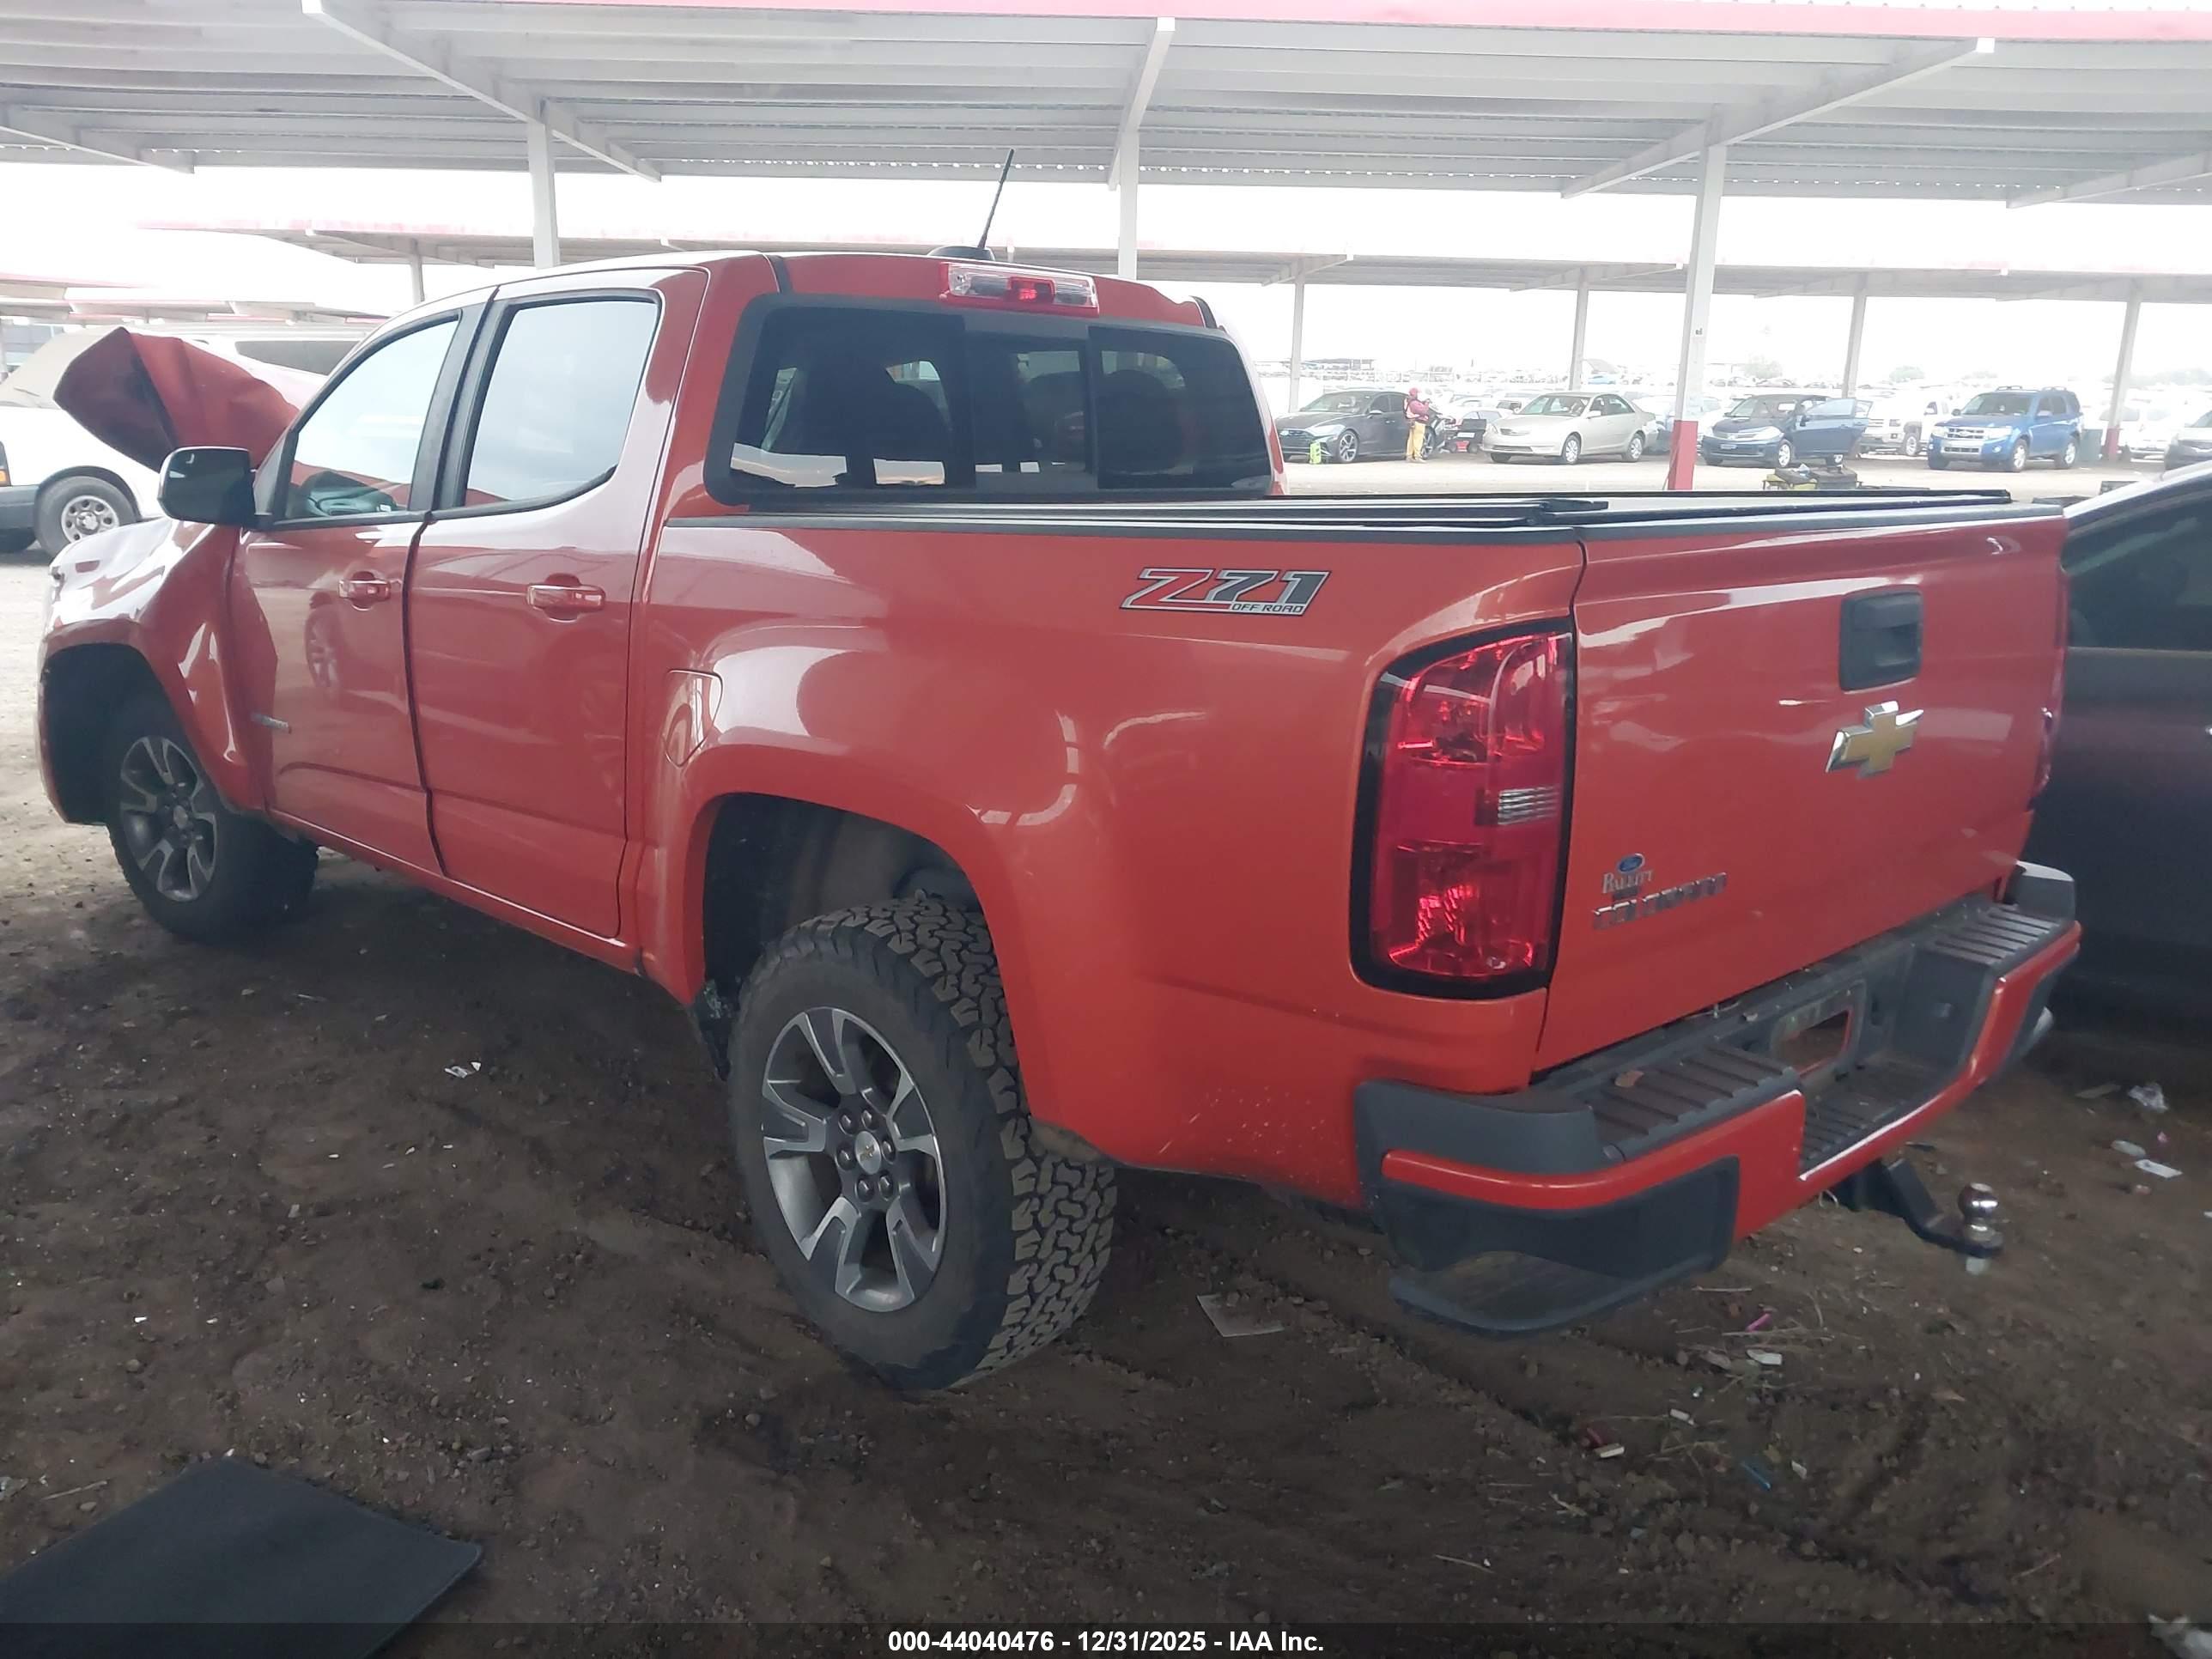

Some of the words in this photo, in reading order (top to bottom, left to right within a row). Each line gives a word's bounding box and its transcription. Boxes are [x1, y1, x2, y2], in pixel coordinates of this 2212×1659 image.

[1120, 568, 1332, 616] Z71
[1231, 603, 1259, 612] OFF
[1261, 604, 1304, 614] ROAD
